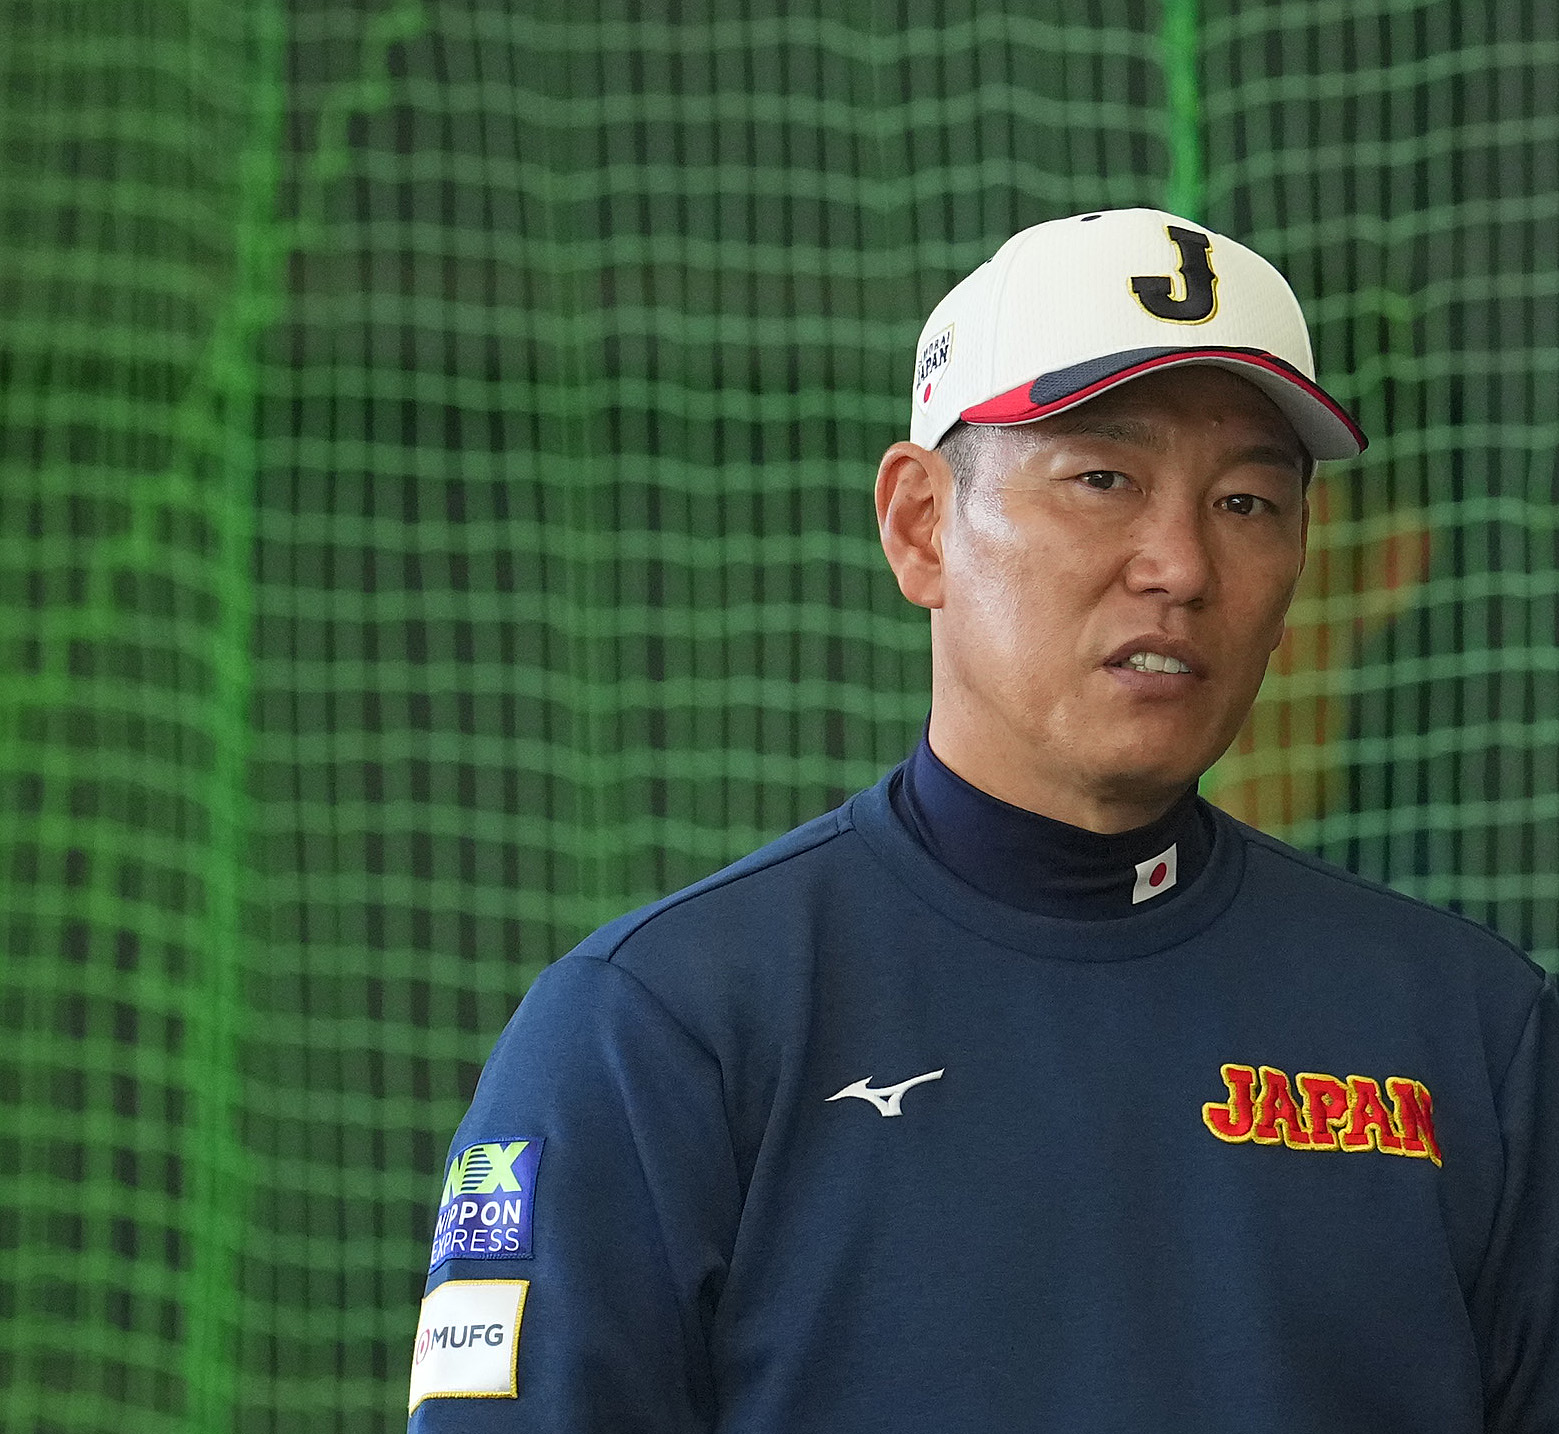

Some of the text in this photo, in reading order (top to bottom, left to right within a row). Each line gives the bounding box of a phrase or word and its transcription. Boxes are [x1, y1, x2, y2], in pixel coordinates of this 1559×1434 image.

[1128, 224, 1218, 326] J
[1202, 1063, 1443, 1168] JAPAN
[440, 1141, 530, 1208] NX
[434, 1199, 522, 1239] NIPPON
[431, 1227, 520, 1265] EXPRESS
[431, 1323, 504, 1350] MUFG
